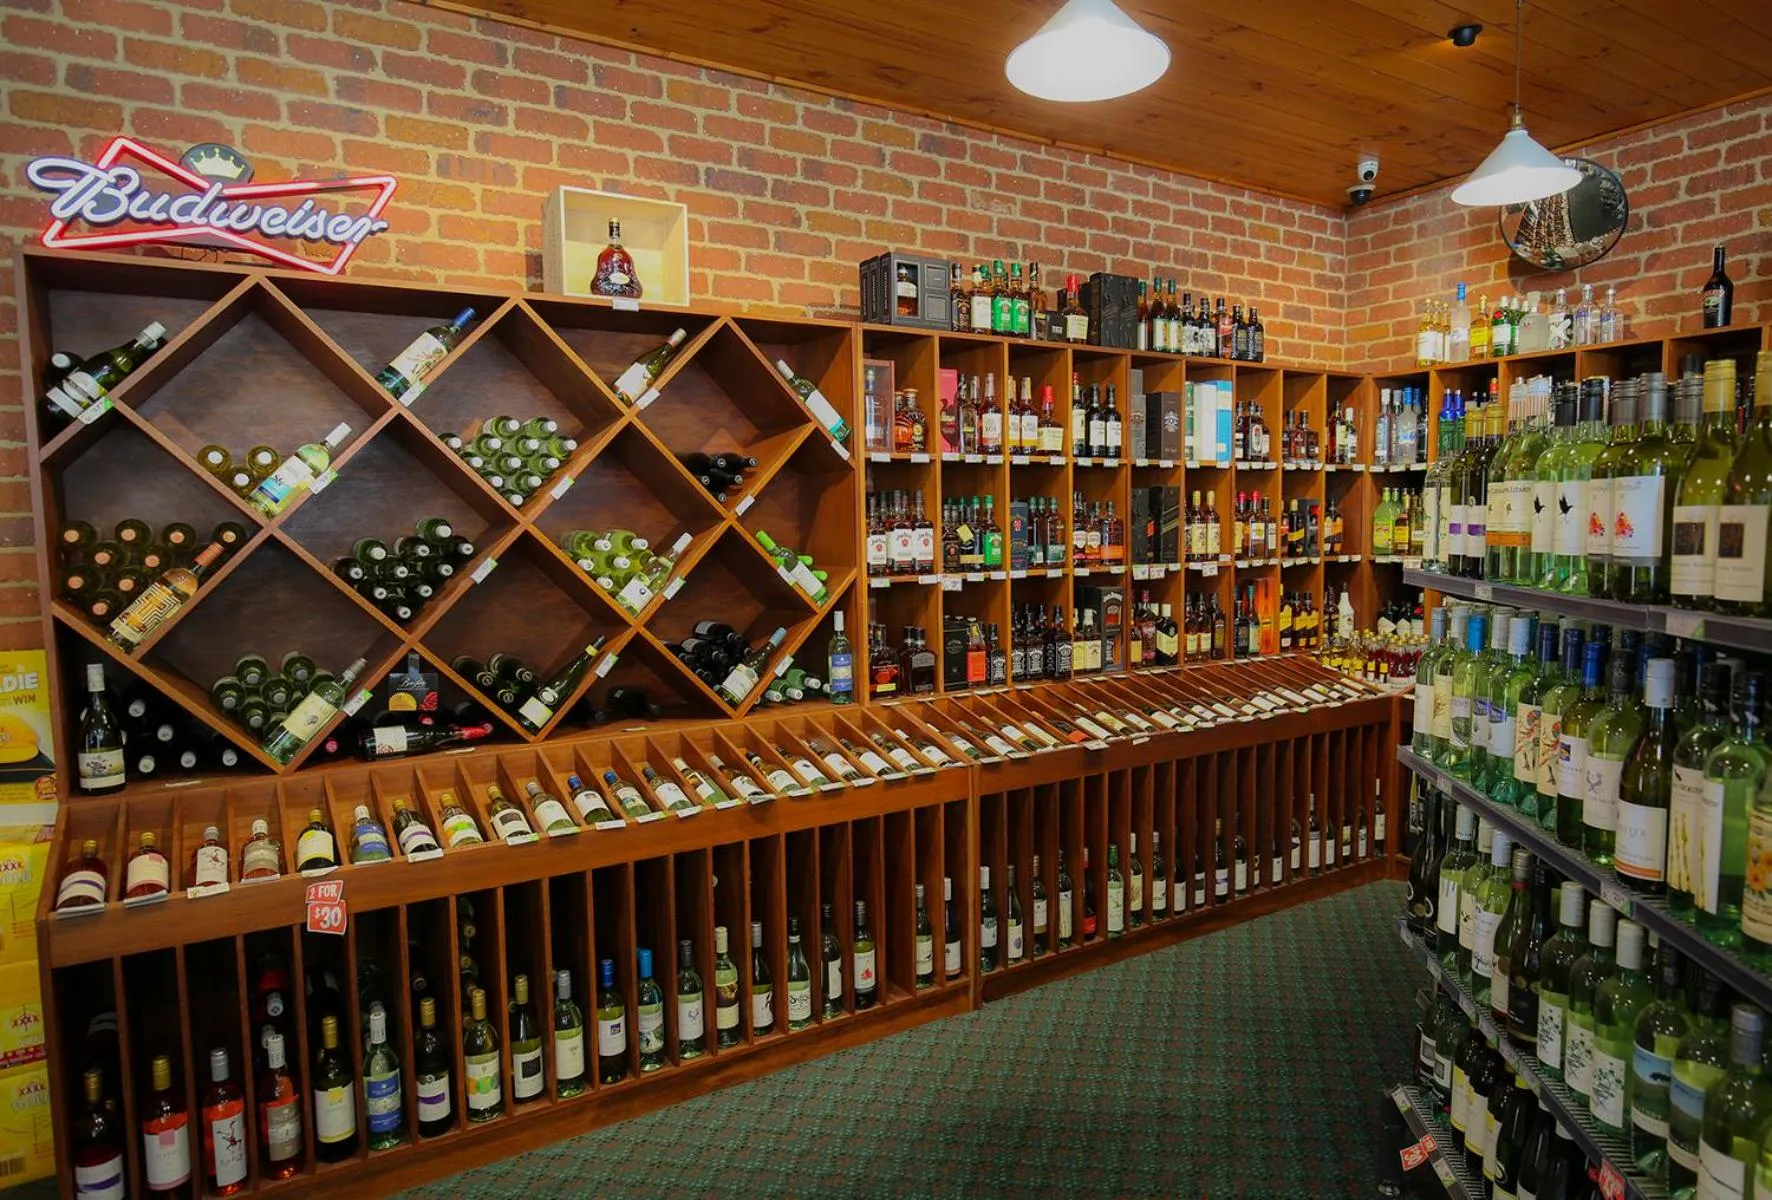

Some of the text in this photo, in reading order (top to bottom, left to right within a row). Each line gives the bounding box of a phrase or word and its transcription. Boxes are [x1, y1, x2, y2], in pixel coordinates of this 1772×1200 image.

[26, 157, 388, 243] Budweiser
[309, 884, 338, 899] 2 FOR
[315, 906, 342, 929] $30
